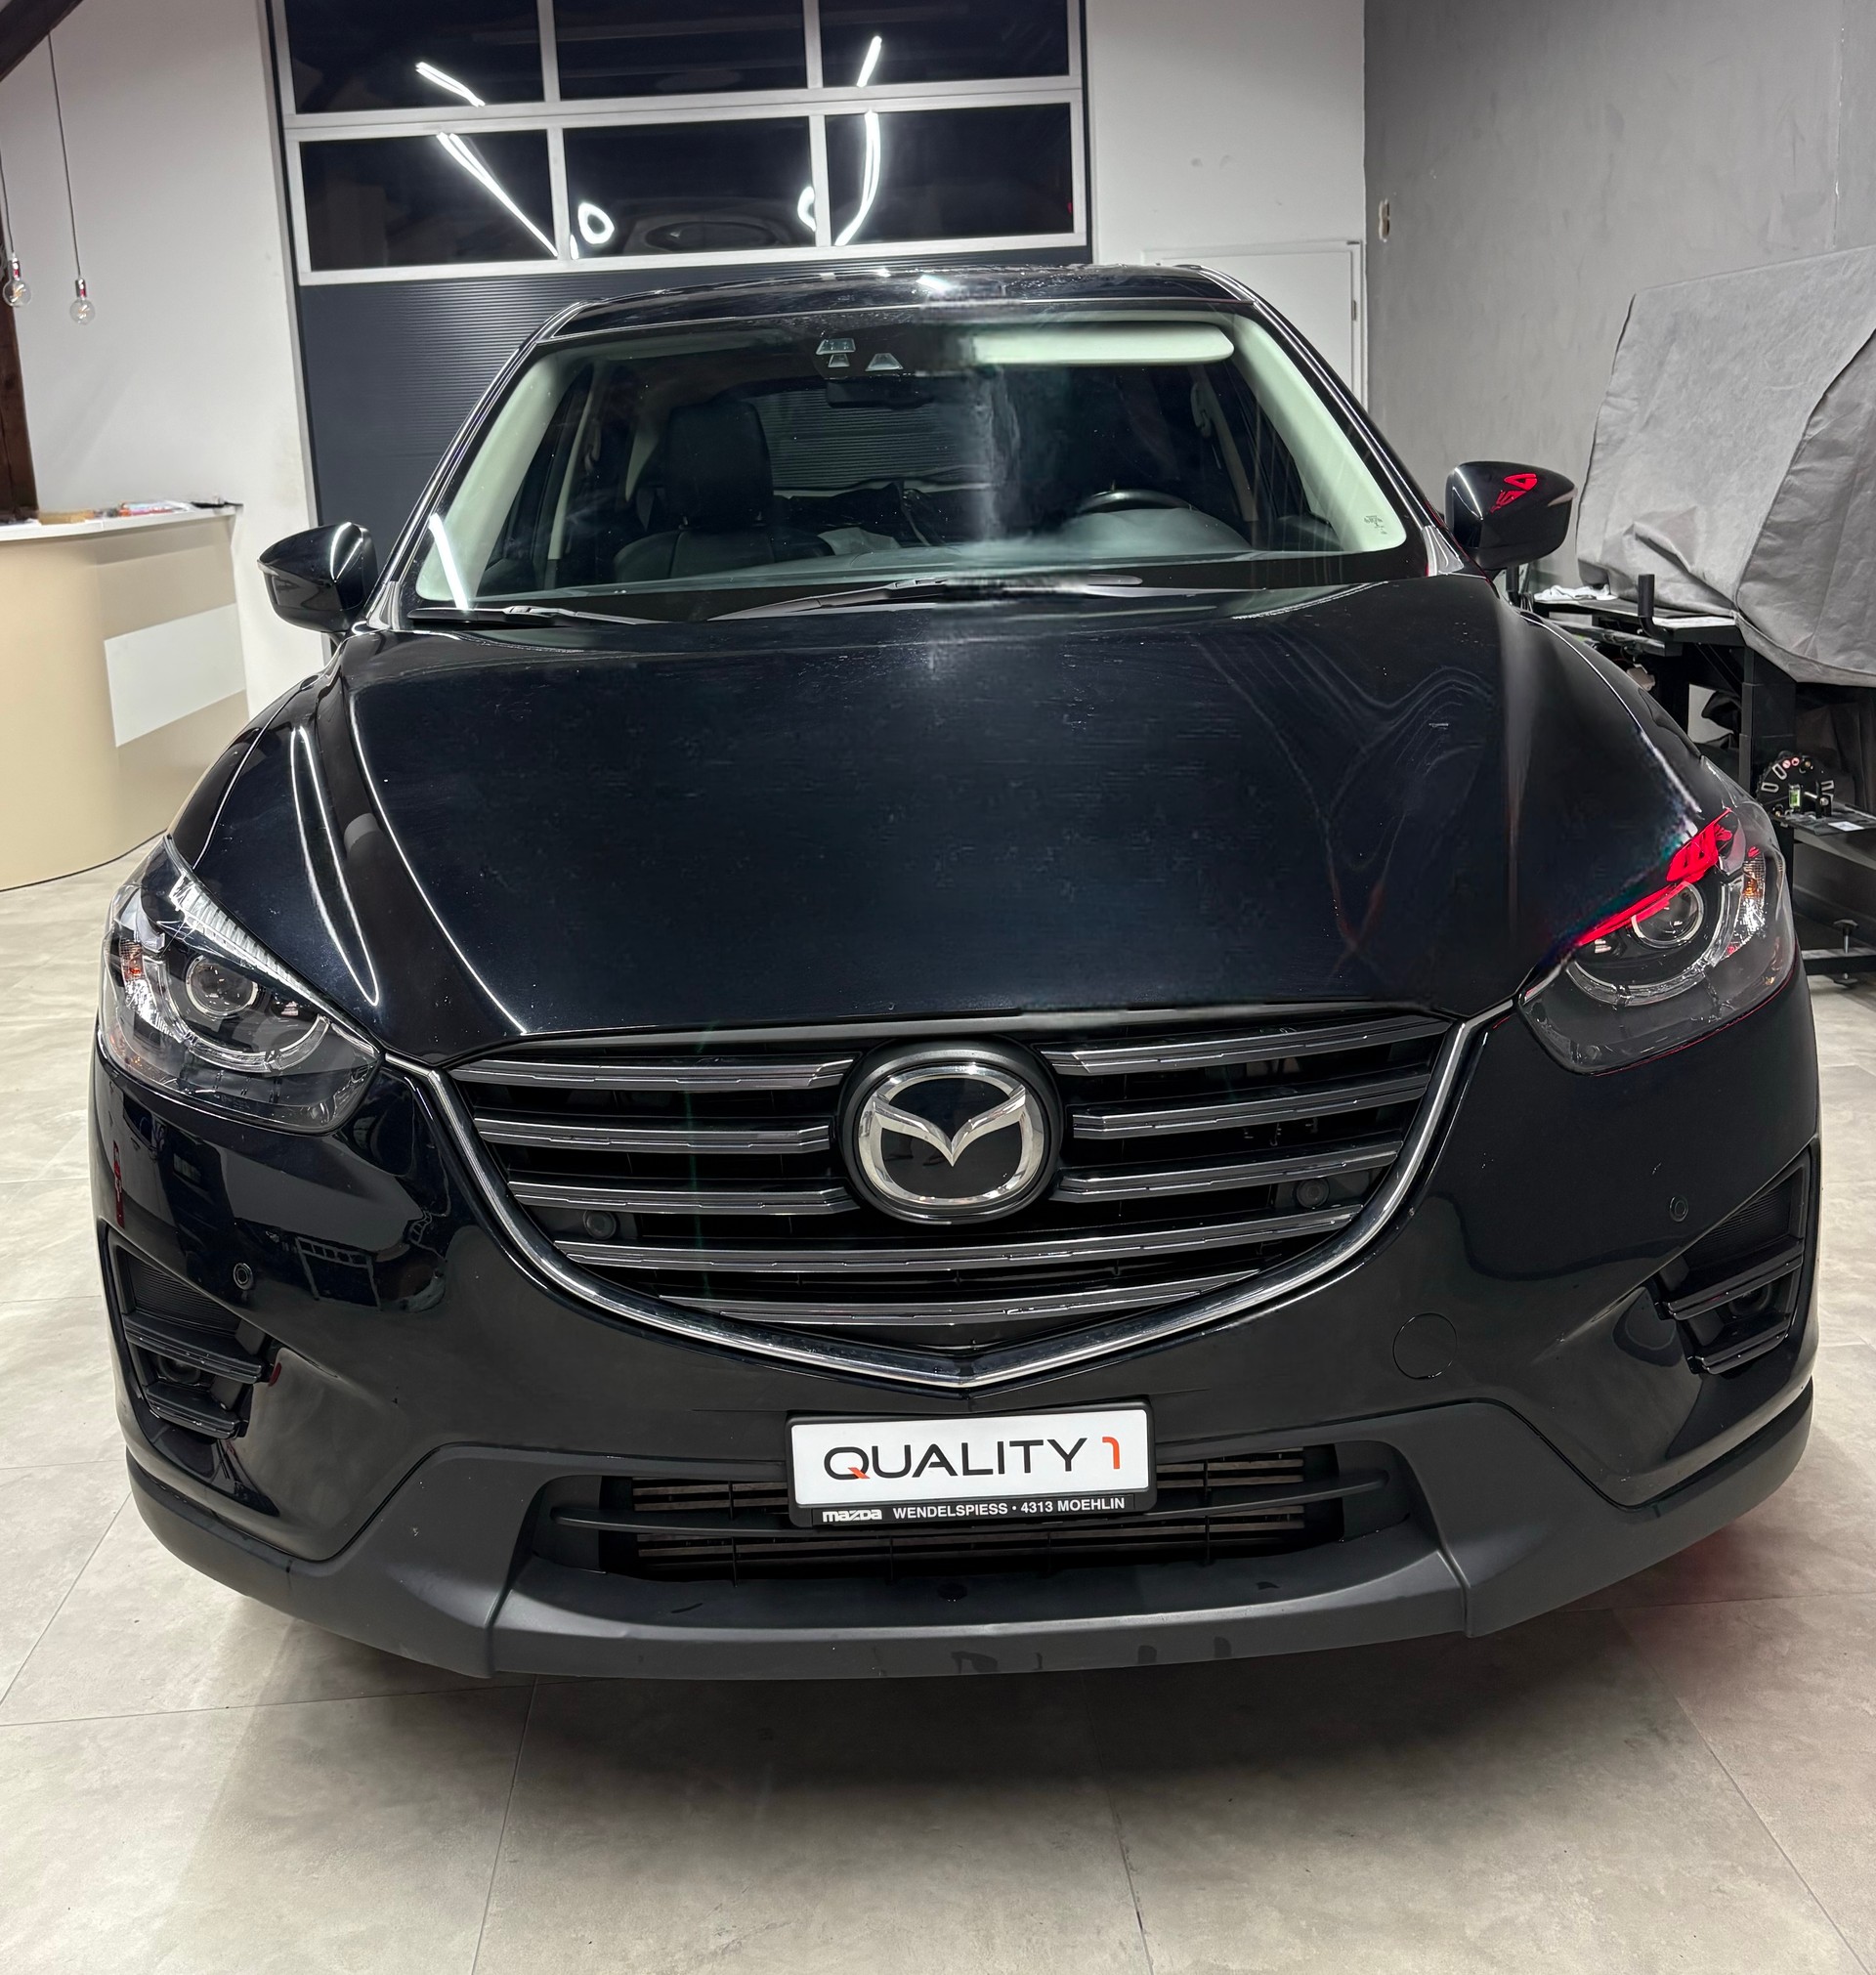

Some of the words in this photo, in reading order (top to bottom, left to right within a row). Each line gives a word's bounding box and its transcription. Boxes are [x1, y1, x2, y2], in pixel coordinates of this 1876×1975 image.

[824, 1437, 1087, 1481] QUALITY
[1101, 1436, 1121, 1470] 1
[893, 1502, 1008, 1520] WENDELSPIESS
[1020, 1500, 1053, 1514] 4313
[1057, 1497, 1126, 1513] MOEHLIN
